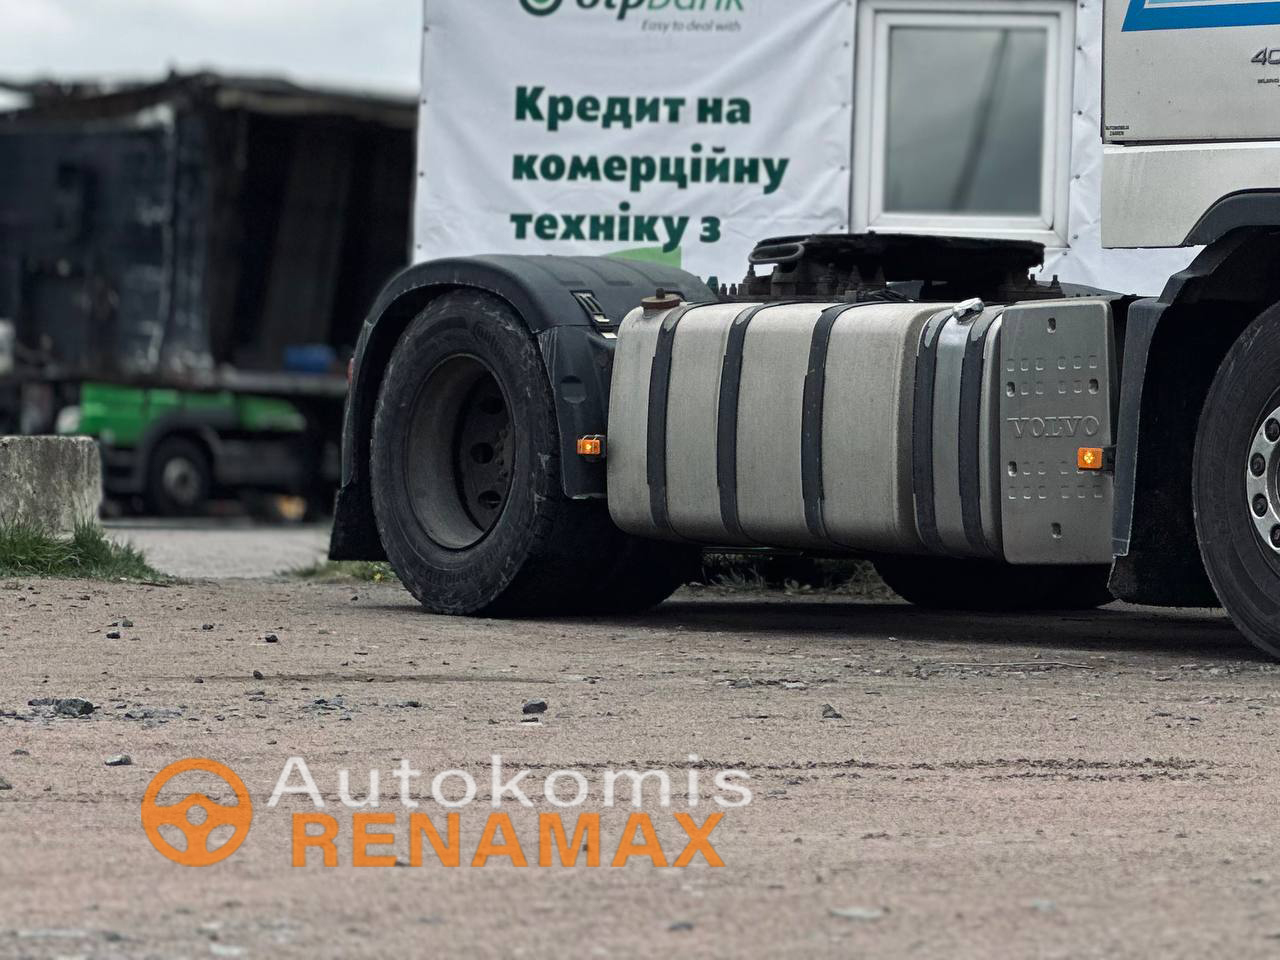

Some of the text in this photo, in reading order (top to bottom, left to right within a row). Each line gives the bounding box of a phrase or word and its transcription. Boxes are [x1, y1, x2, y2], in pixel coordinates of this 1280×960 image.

[514, 85, 751, 132] Кредит на
[511, 142, 790, 194] комерційну
[509, 200, 722, 254] техніку з
[1006, 415, 1100, 438] VOLVO
